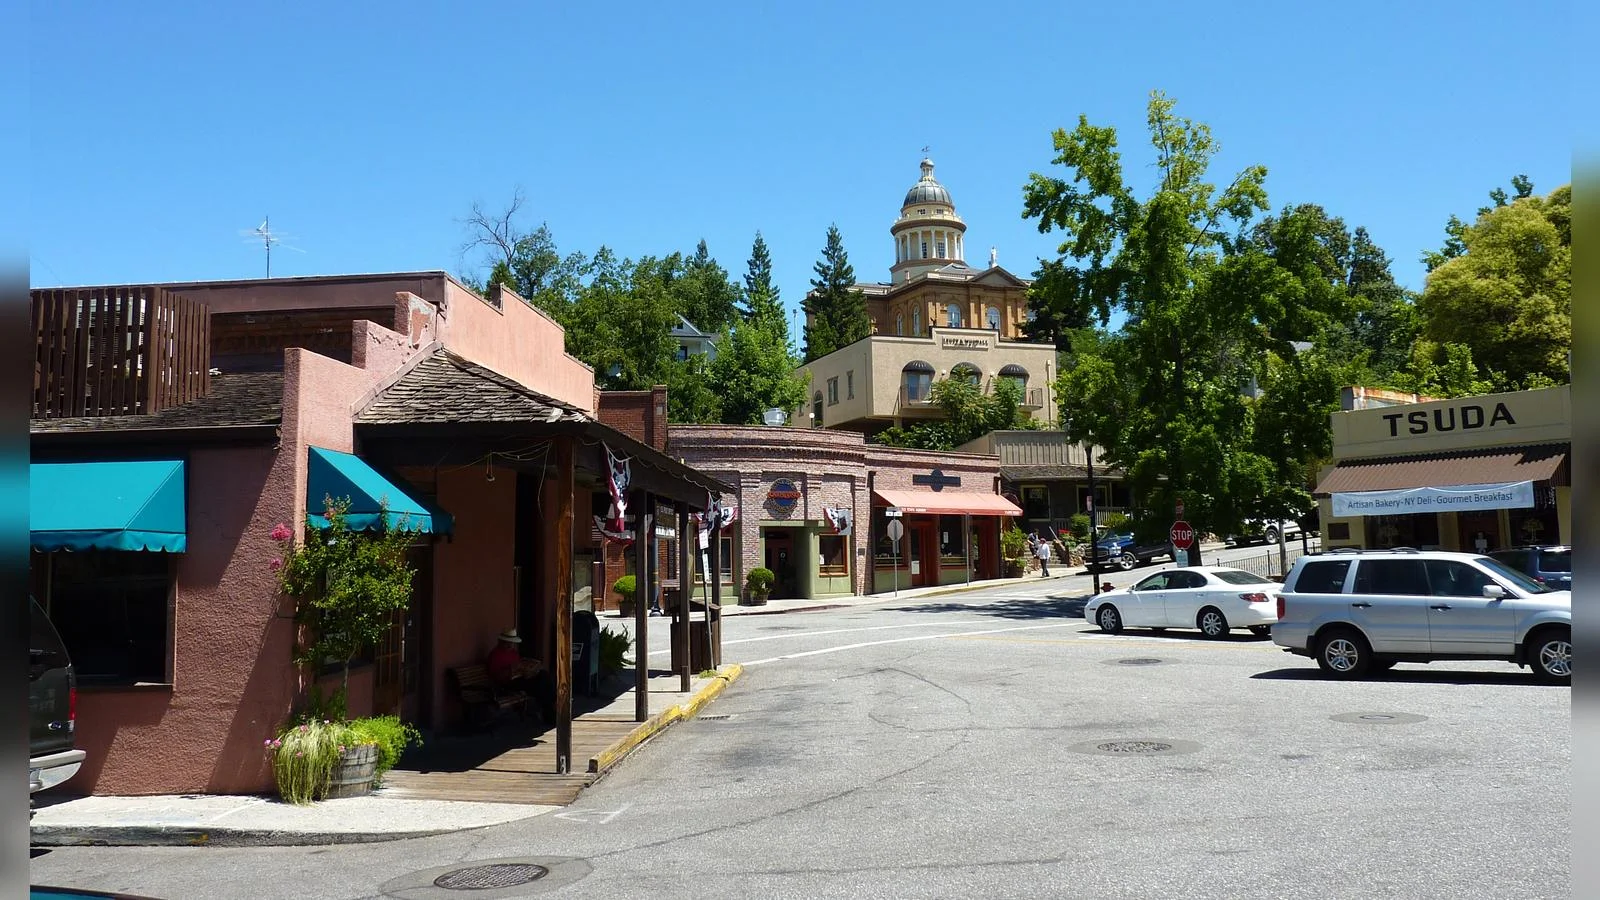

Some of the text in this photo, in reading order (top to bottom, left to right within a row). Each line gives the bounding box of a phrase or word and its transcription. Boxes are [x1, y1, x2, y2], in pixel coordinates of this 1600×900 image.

[1382, 402, 1517, 437] TSUDA
[1347, 501, 1373, 509] Artisan
[1474, 491, 1513, 502] Breakfast
[1171, 529, 1192, 541] STOP
